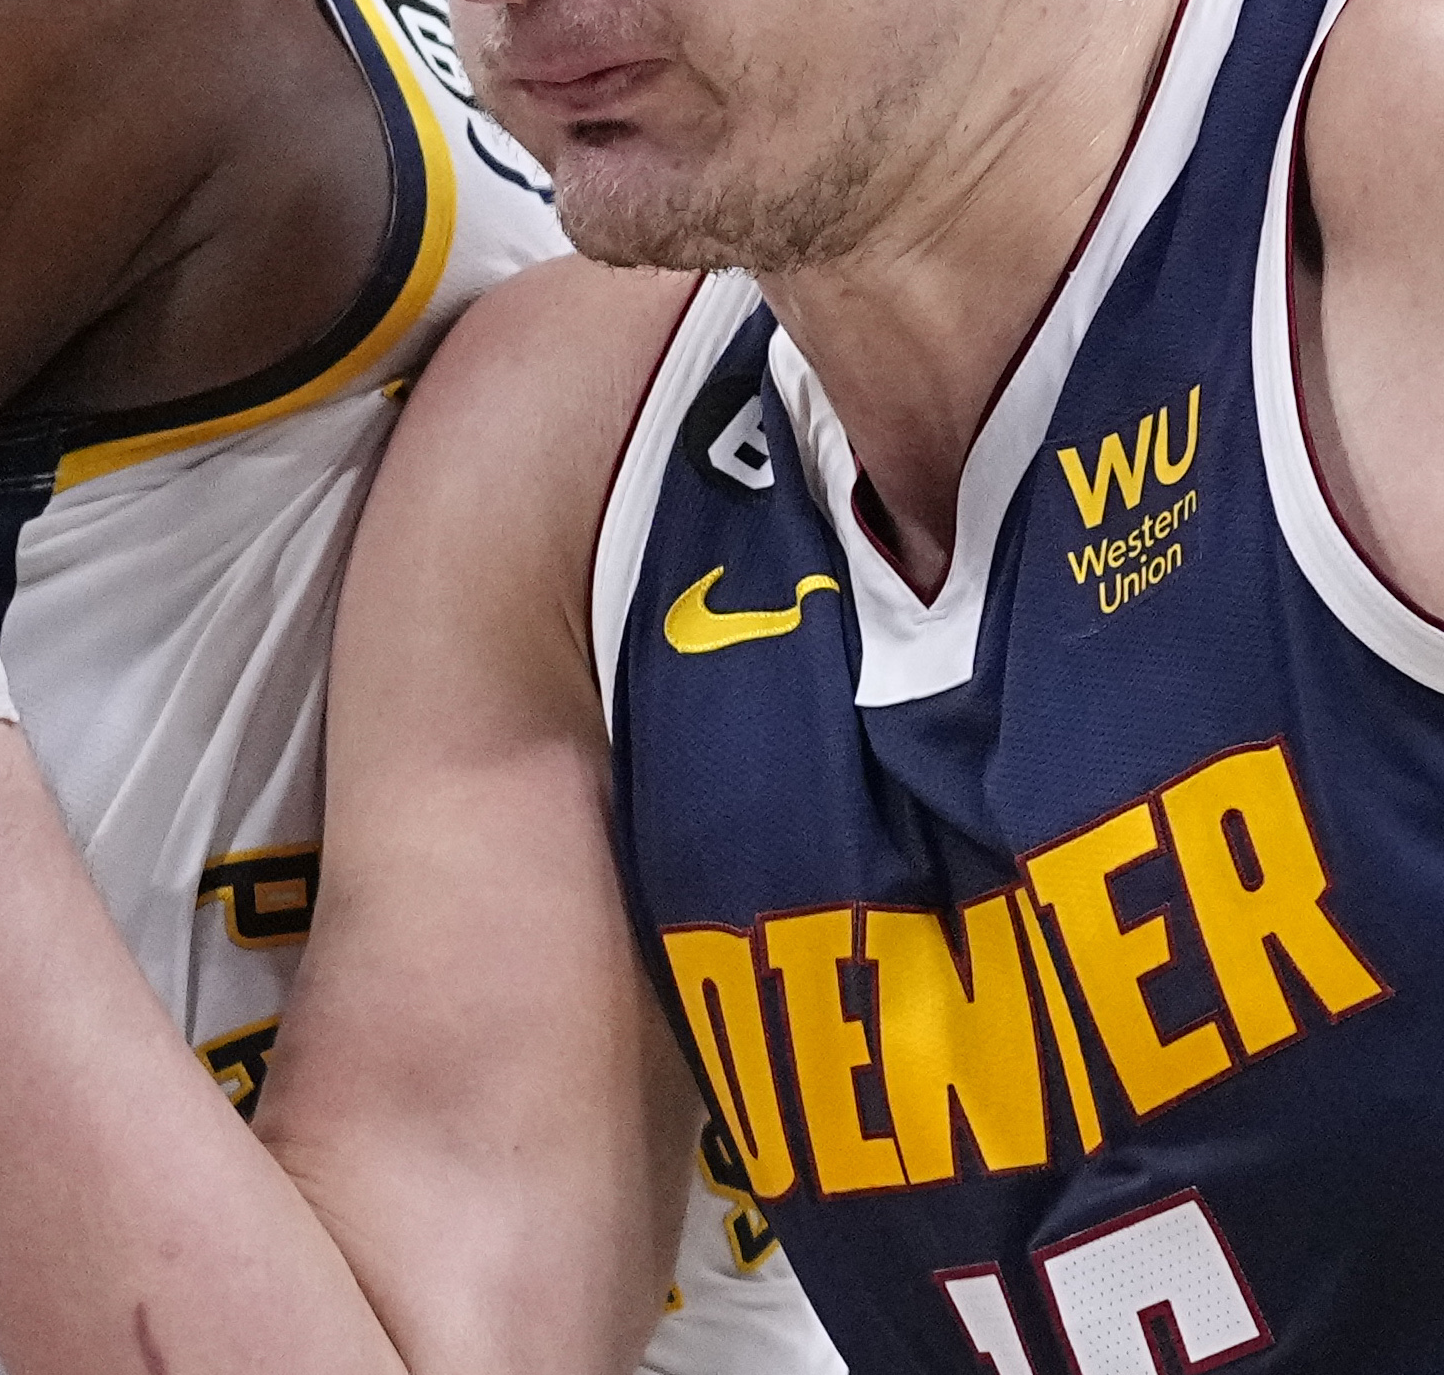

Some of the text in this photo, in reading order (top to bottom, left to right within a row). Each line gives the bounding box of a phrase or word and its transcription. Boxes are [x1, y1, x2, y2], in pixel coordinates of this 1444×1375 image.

[1056, 384, 1201, 530] WU
[1067, 490, 1197, 585] Western
[1099, 554, 1183, 615] Union
[661, 736, 1394, 1199] DENER
